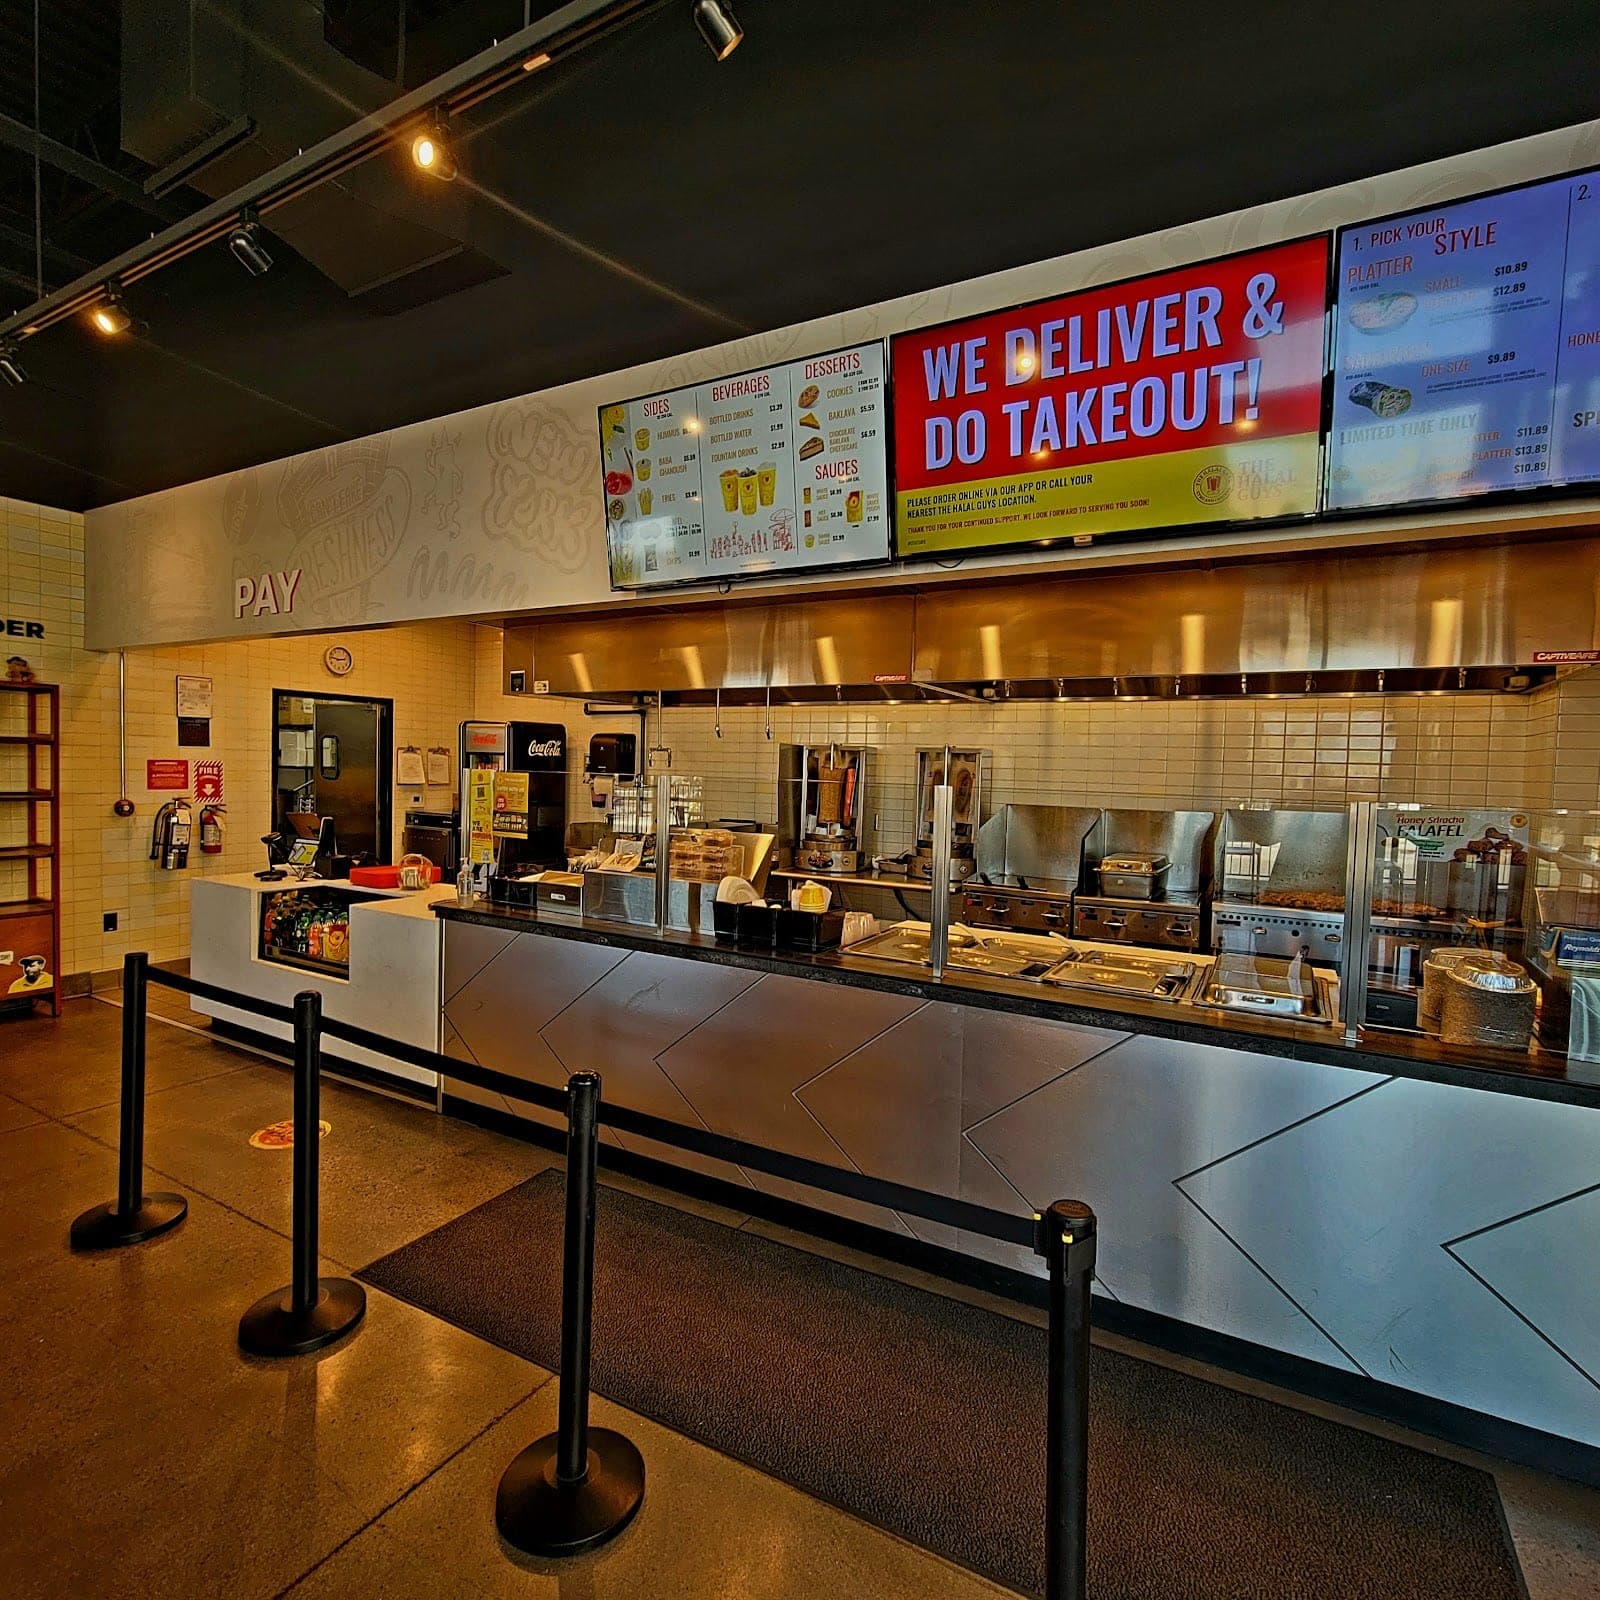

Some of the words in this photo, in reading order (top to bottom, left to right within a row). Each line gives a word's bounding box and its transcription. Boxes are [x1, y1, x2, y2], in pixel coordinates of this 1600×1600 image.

[1353, 236, 1363, 251] 1.
[1370, 228, 1402, 248] PICK
[1407, 217, 1446, 240] YOUR
[1434, 221, 1498, 255] STYLE
[1347, 255, 1414, 284] PLATTER
[1494, 261, 1528, 277] $10.89
[1423, 276, 1463, 293] SMALL
[1493, 282, 1526, 297] $12.89
[921, 336, 987, 402] WE
[1004, 286, 1223, 386] DELIVER
[1242, 272, 1284, 339] &
[805, 352, 861, 380] DESSERTS
[1487, 351, 1516, 365] $9.89
[1421, 364, 1445, 378] ONE
[1447, 359, 1472, 375] SIZE
[712, 375, 770, 402] BEVERAGES
[826, 385, 855, 400] COOKIES
[643, 398, 670, 417] SIDES
[709, 413, 733, 425] BOTTLED
[733, 408, 754, 420] DRINKS
[828, 407, 856, 421] BAKLAVA
[924, 409, 986, 471] DO
[1002, 357, 1262, 458] TAKEOUT!
[710, 432, 733, 444] BOTTLED
[733, 428, 752, 440] WATER
[1340, 425, 1395, 445] LIMITED
[1400, 420, 1433, 437] TIME
[1440, 413, 1477, 430] ONLY
[1516, 425, 1548, 438] $11.89
[711, 450, 737, 463] FOUNTAIN
[737, 446, 759, 458] DRINKS
[1472, 448, 1512, 461] PLATTER
[1514, 443, 1548, 457] $13.89
[815, 459, 858, 480] SAUCES
[1238, 458, 1274, 475] THE
[1513, 461, 1547, 474] $10.89
[1238, 470, 1297, 488] HALAL
[907, 498, 932, 507] PLEASE
[933, 494, 957, 504] ORDER
[958, 490, 984, 501] ONLINE
[985, 488, 998, 497] VIA
[1000, 485, 1016, 495] OUR
[1018, 482, 1034, 493] APP
[1035, 480, 1047, 490] OR
[1049, 477, 1067, 489] CALL
[1070, 474, 1093, 486] YOUR
[1238, 486, 1282, 501] GUYS
[907, 508, 936, 519] NEAREST
[937, 505, 951, 514] THE
[952, 502, 975, 513] HALAL
[976, 499, 996, 510] GUYS
[998, 495, 1037, 507] LOCATION.
[907, 526, 924, 534] THANK
[925, 524, 936, 532] YOU
[937, 522, 947, 530] FOR
[948, 521, 963, 529] YOUR
[963, 518, 994, 527] CONTINUED
[1022, 512, 1032, 520] WE
[1032, 511, 1048, 519] LOOK
[1049, 507, 1078, 517] FORWARD
[1078, 506, 1087, 514] TO
[1088, 503, 1114, 513] SERVING
[1116, 501, 1129, 510] YOU
[1129, 498, 1150, 508] SOON!
[234, 569, 303, 619] PAY
[1397, 817, 1426, 825] Honey
[1428, 816, 1465, 824] Sriracha
[1397, 825, 1464, 837] FALAFEL
